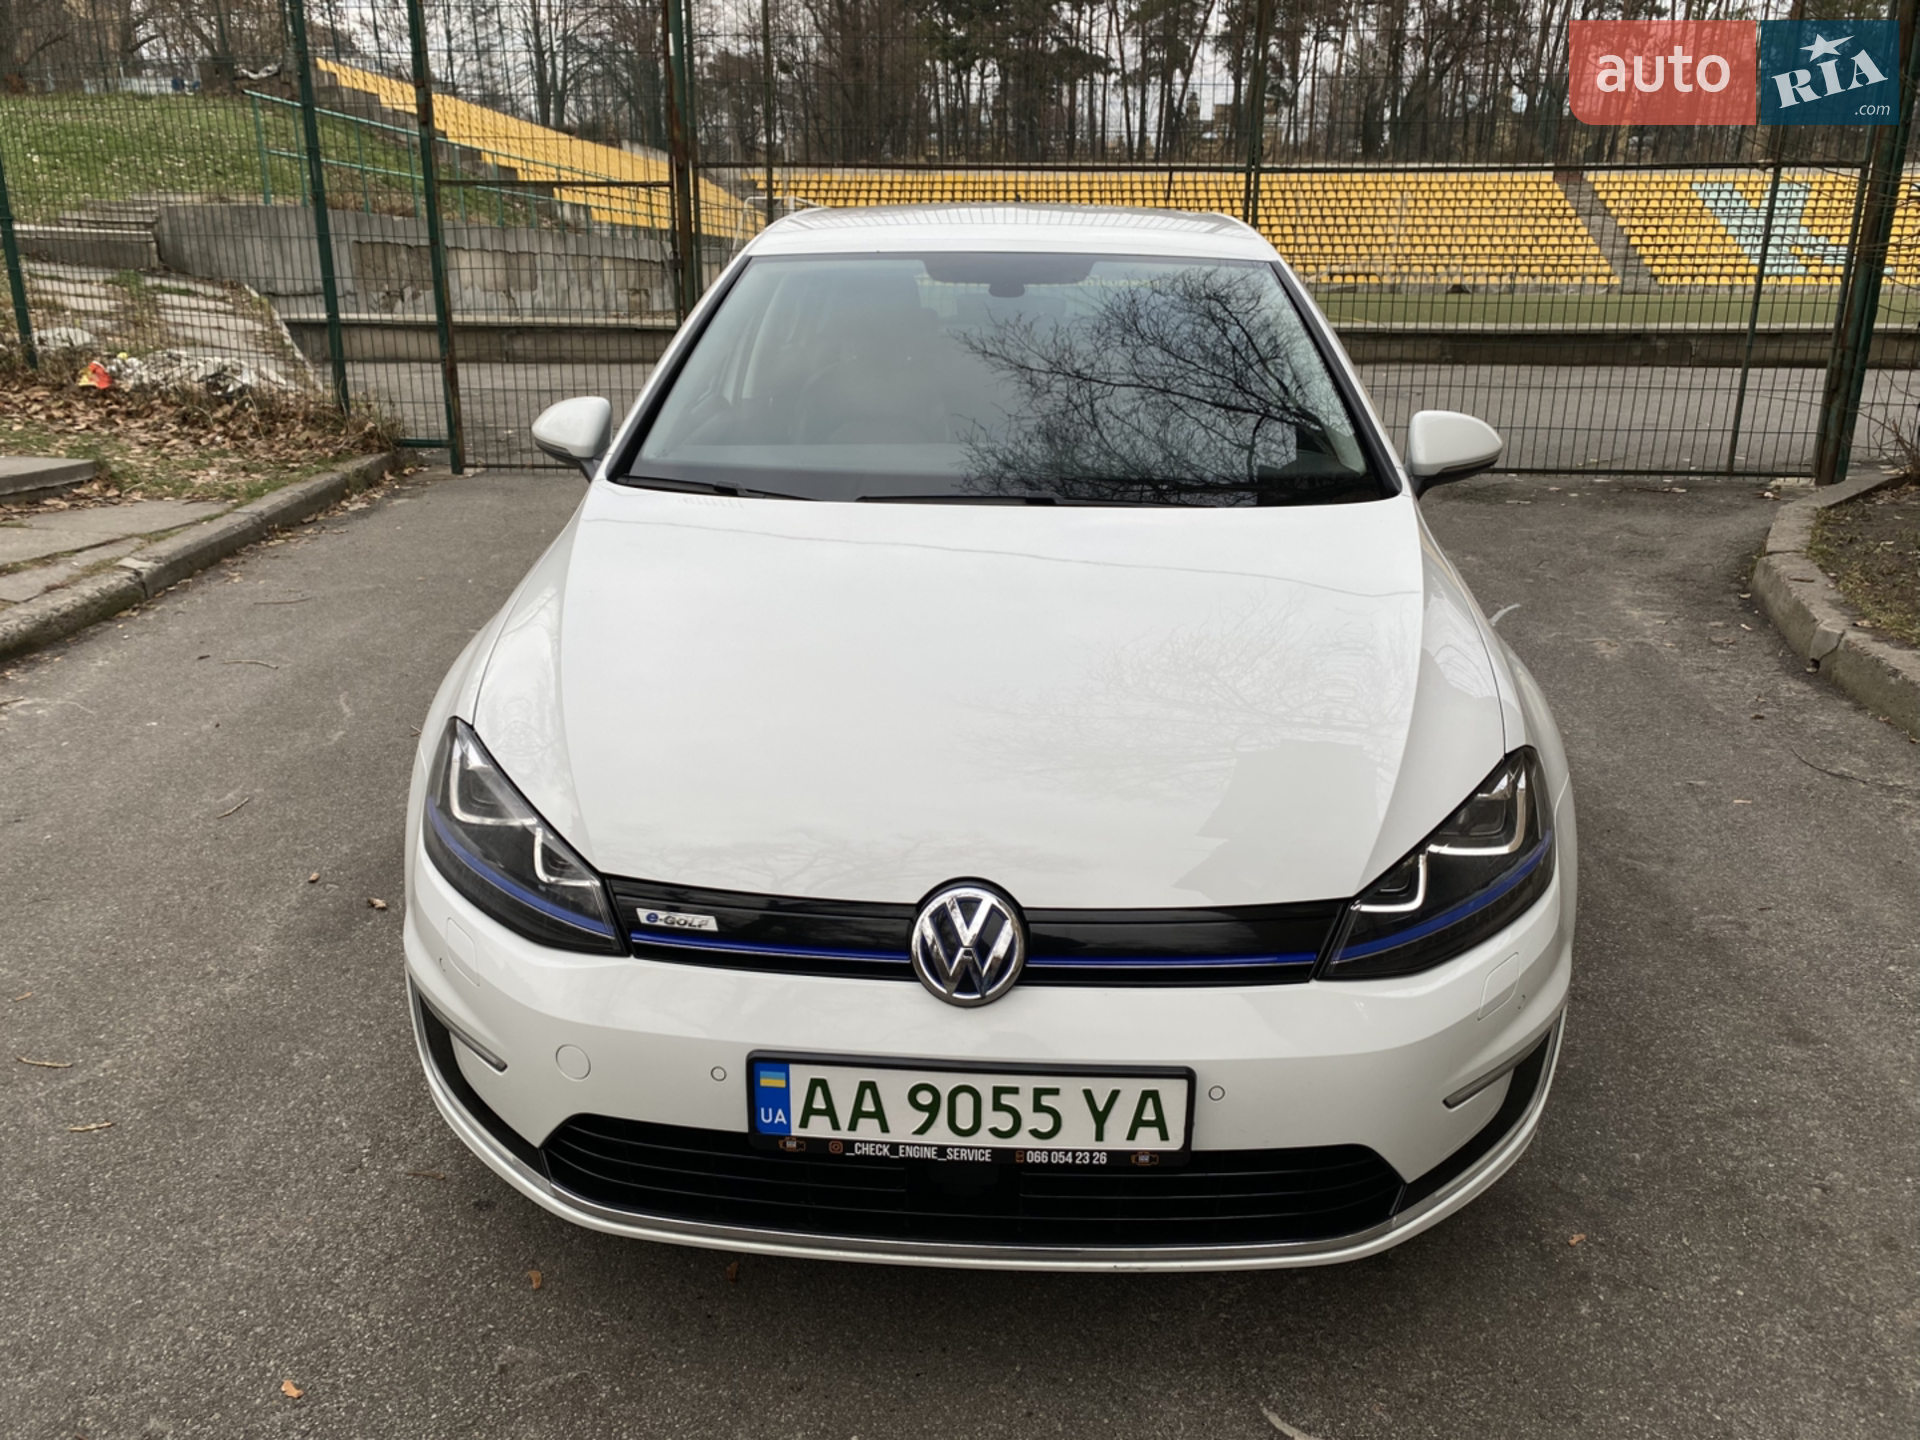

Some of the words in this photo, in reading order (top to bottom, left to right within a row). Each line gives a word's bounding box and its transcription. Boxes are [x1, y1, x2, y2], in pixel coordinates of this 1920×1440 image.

[760, 1107, 788, 1125] UA
[798, 1077, 891, 1134] AA
[907, 1082, 1063, 1140] 9055
[1082, 1088, 1170, 1142] YA
[1026, 1151, 1049, 1164] 066
[1051, 1151, 1073, 1164] 054
[1075, 1151, 1090, 1165] 23
[1092, 1151, 1107, 1165] 26
